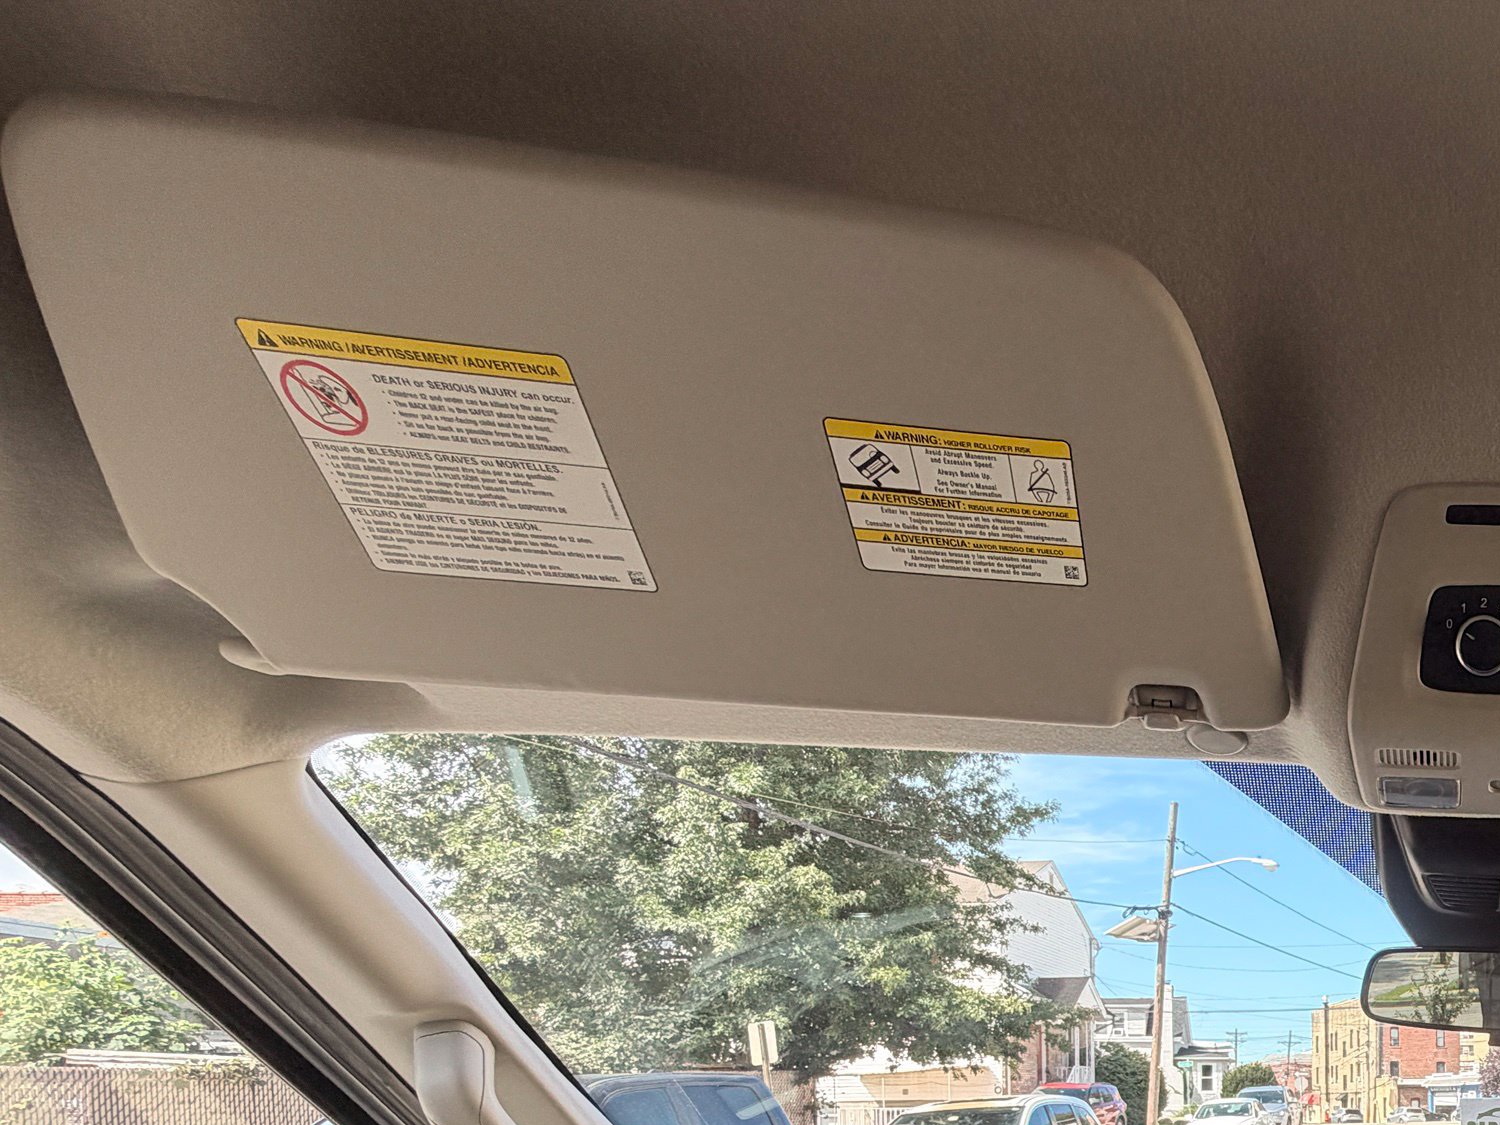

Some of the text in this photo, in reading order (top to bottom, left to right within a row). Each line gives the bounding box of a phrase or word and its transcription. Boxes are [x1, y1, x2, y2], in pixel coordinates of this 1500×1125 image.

[277, 334, 344, 352] WARNING
[372, 374, 575, 404] DEATH or SERIOUS INJURY can occur.
[884, 431, 942, 445] WARNING:
[312, 440, 350, 453] Risque
[352, 445, 366, 454] de
[367, 447, 433, 460] BLESSURES
[434, 453, 479, 466] GRAVES
[496, 460, 564, 474] MORTELLES.
[871, 492, 967, 510] AVERTISSEMENT:
[349, 507, 398, 519] PELIGRO
[399, 512, 412, 520] de
[413, 513, 458, 524] MUERTE
[467, 518, 500, 528] SERIA
[893, 533, 971, 548] ADVERTENCIA:
[1461, 603, 1466, 613] 1
[1480, 597, 1488, 608] 2
[1446, 618, 1453, 628] 0
